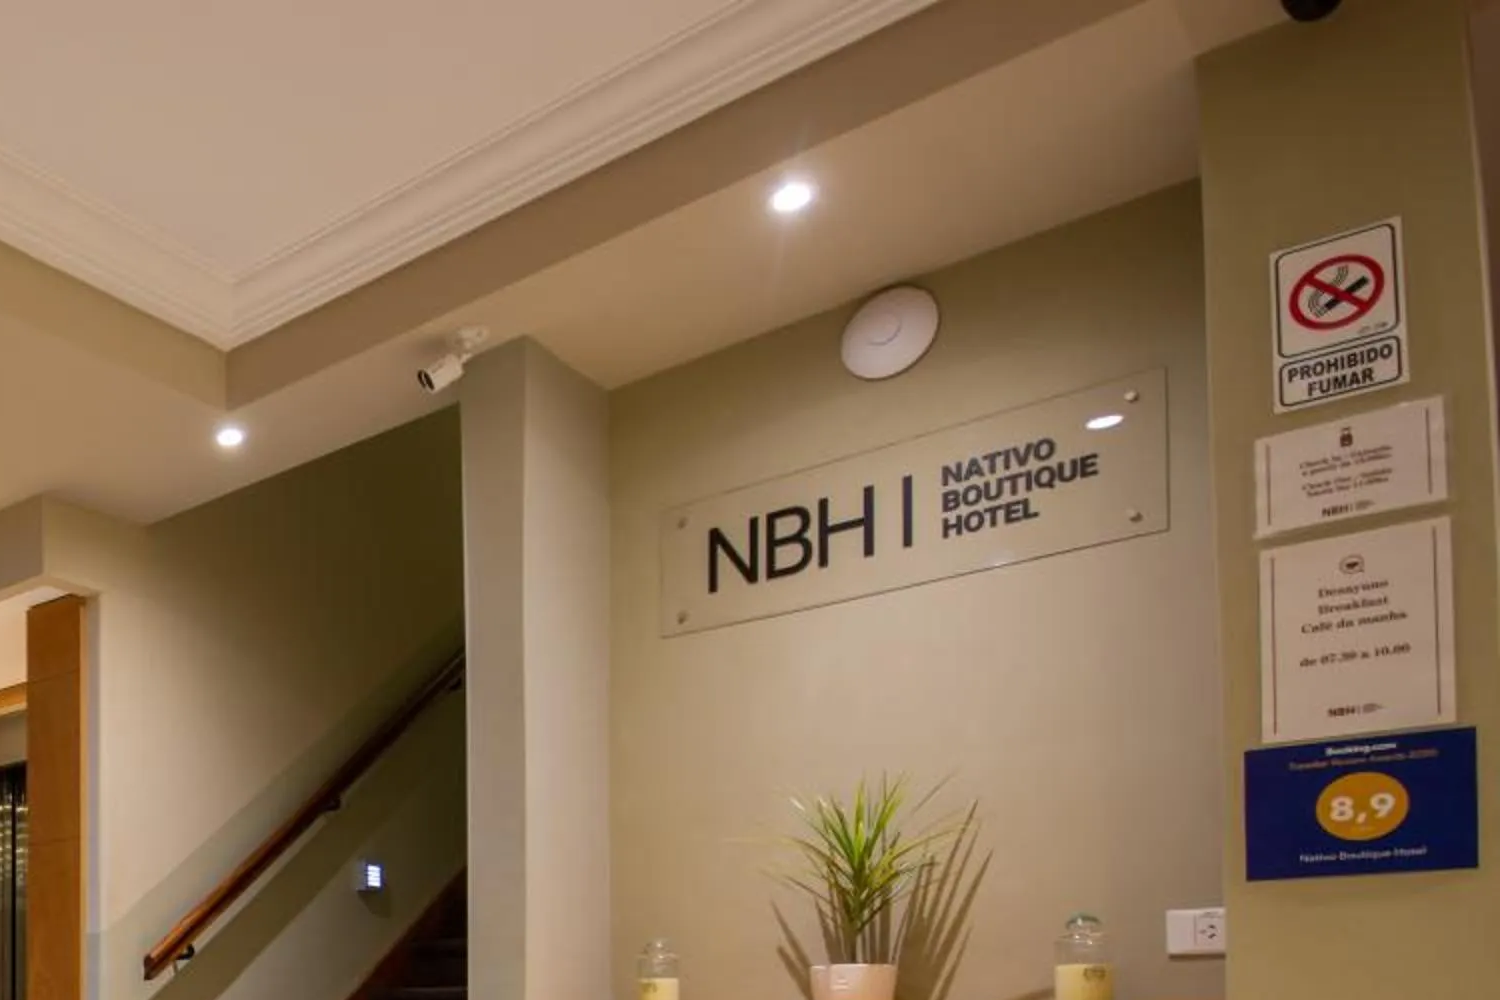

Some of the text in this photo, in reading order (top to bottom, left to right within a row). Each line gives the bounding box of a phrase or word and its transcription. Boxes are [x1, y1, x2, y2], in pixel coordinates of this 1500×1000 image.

[1287, 343, 1393, 383] PROHIBIDO
[1307, 367, 1374, 396] FUMAR
[941, 438, 1056, 487] NATIVO
[942, 453, 1099, 513] BOUTIQUE
[942, 498, 1041, 539] HOTEL
[707, 484, 875, 595] NBH
[1318, 580, 1389, 598] Desayuno
[1318, 596, 1388, 615] Breakfast
[1329, 793, 1396, 824] 8,9
